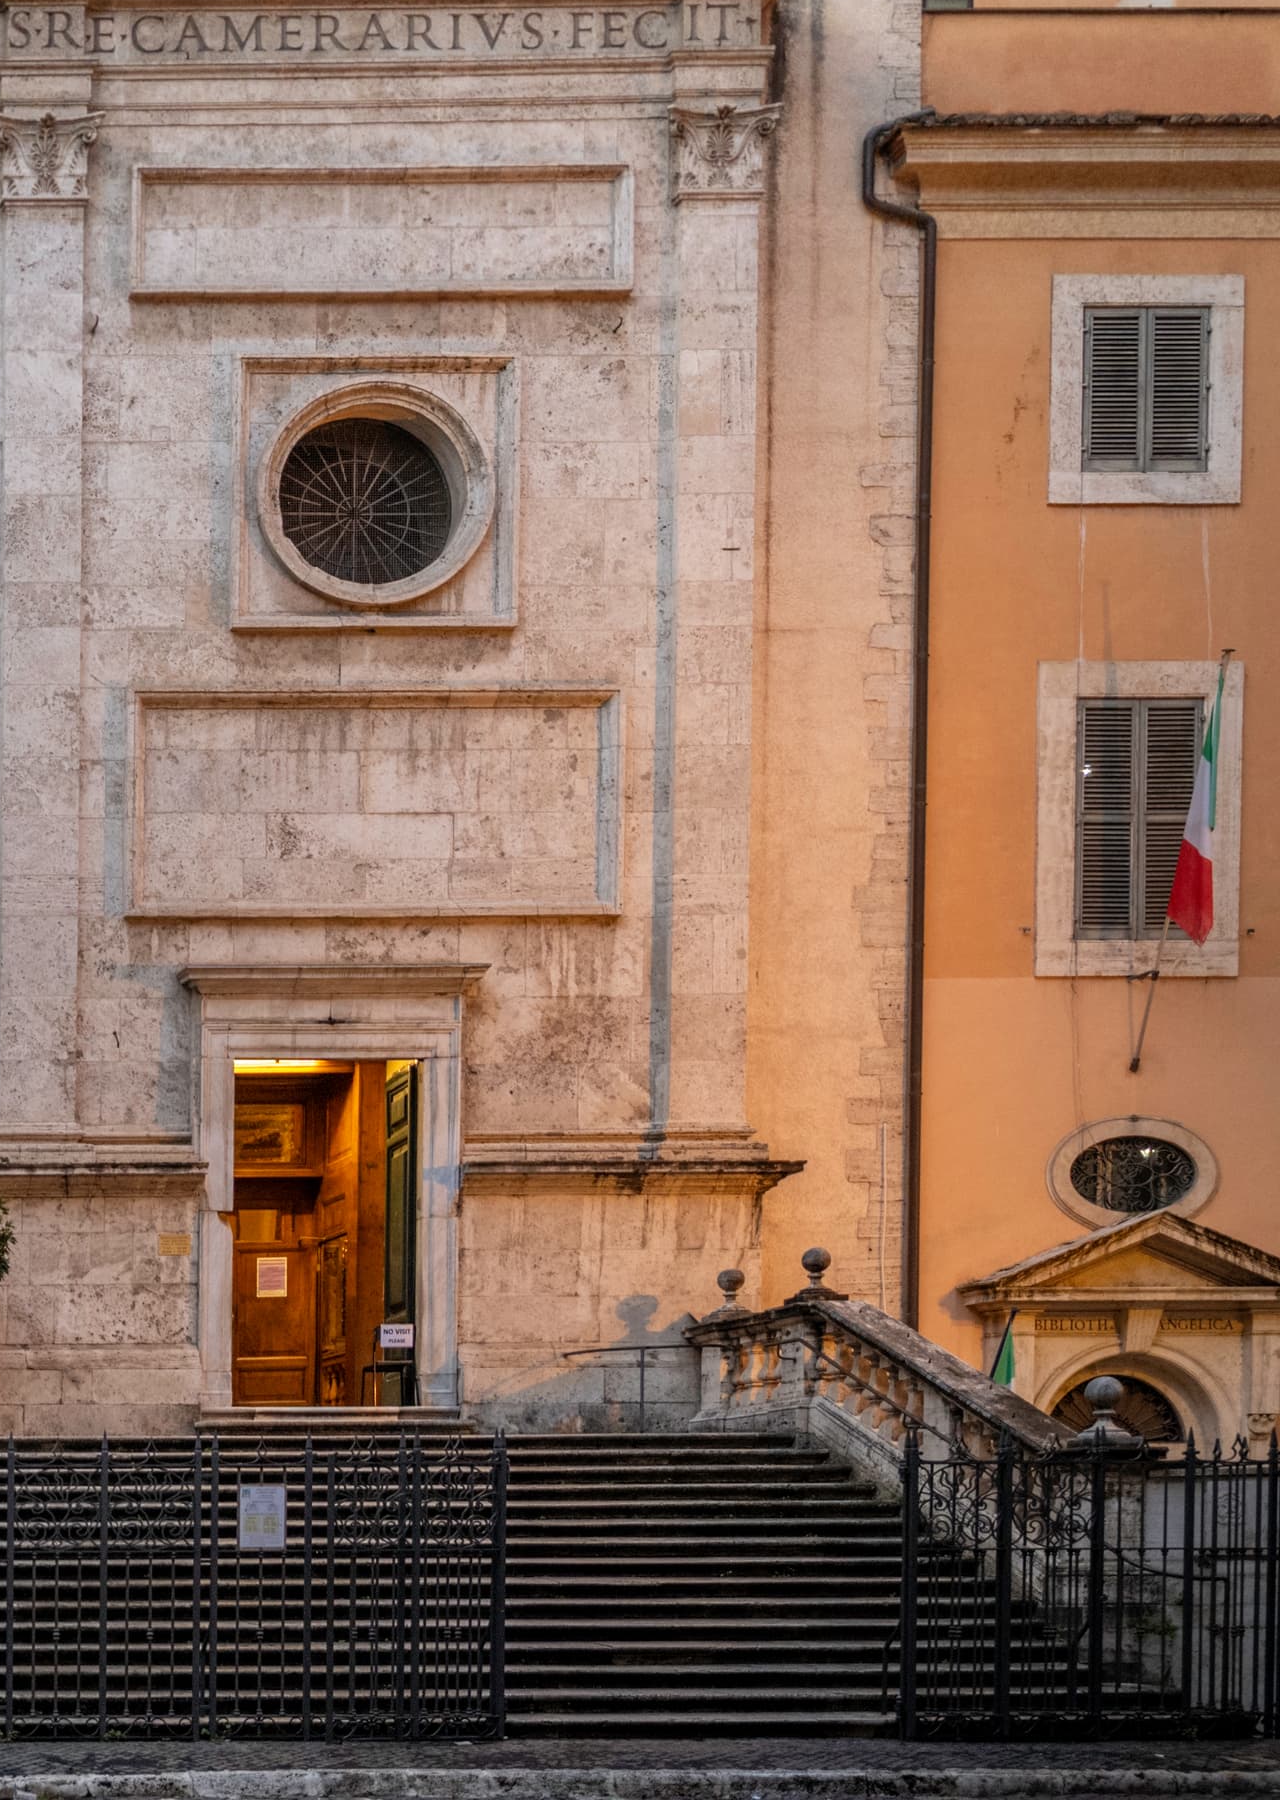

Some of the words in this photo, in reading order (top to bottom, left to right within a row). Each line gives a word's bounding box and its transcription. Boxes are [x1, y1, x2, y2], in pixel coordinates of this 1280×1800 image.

[131, 11, 543, 54] CAMERARIVS
[571, 3, 740, 49] FECIT
[1158, 1318, 1234, 1331] ANGELICA
